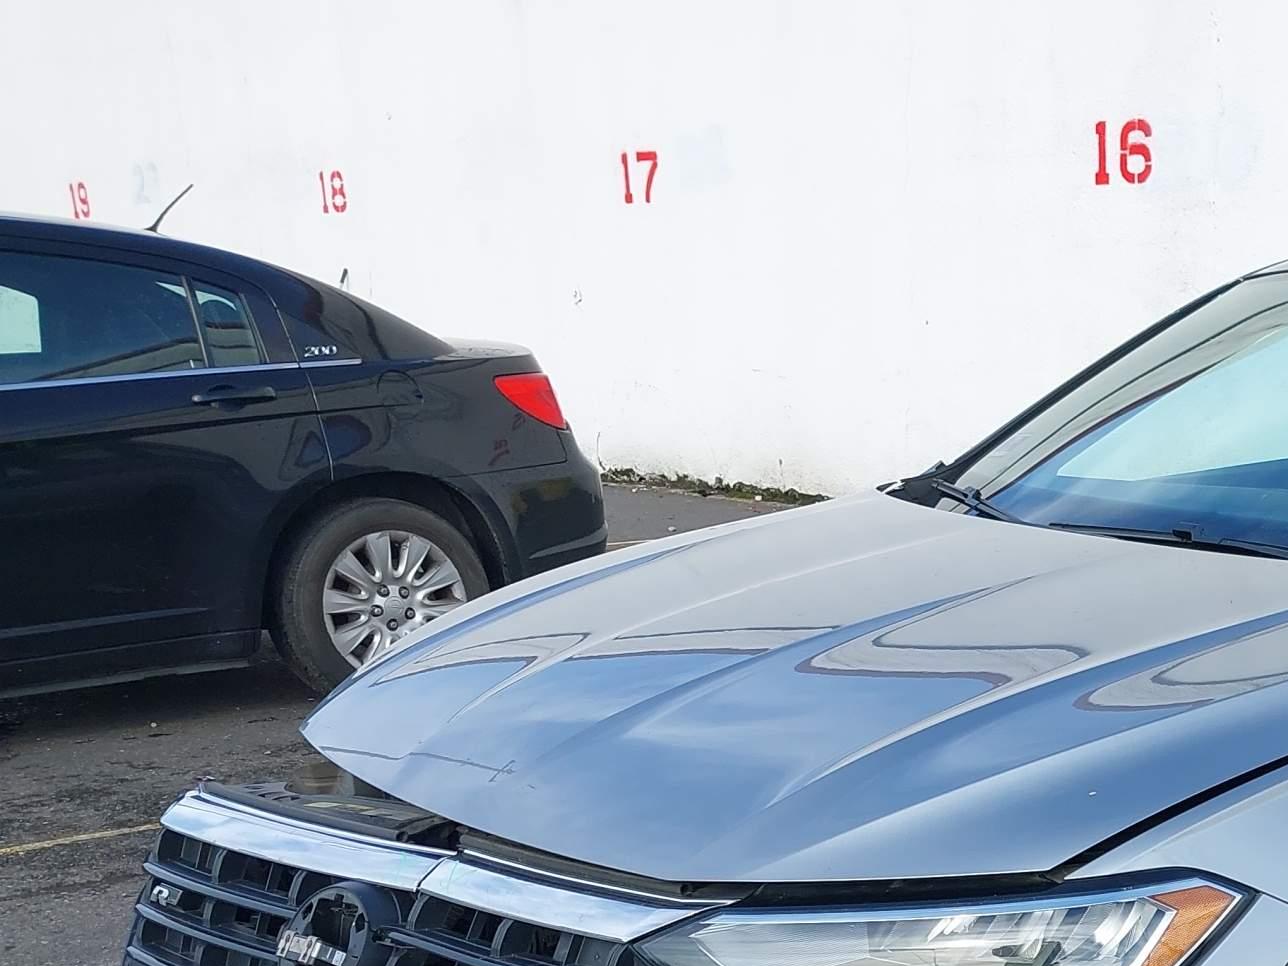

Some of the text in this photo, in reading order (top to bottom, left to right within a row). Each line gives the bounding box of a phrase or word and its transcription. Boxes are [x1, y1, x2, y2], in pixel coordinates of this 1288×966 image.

[1094, 118, 1153, 186] 16
[319, 170, 347, 214] 18
[619, 150, 659, 205] 17
[69, 181, 92, 220] 19
[303, 345, 338, 358] 200
